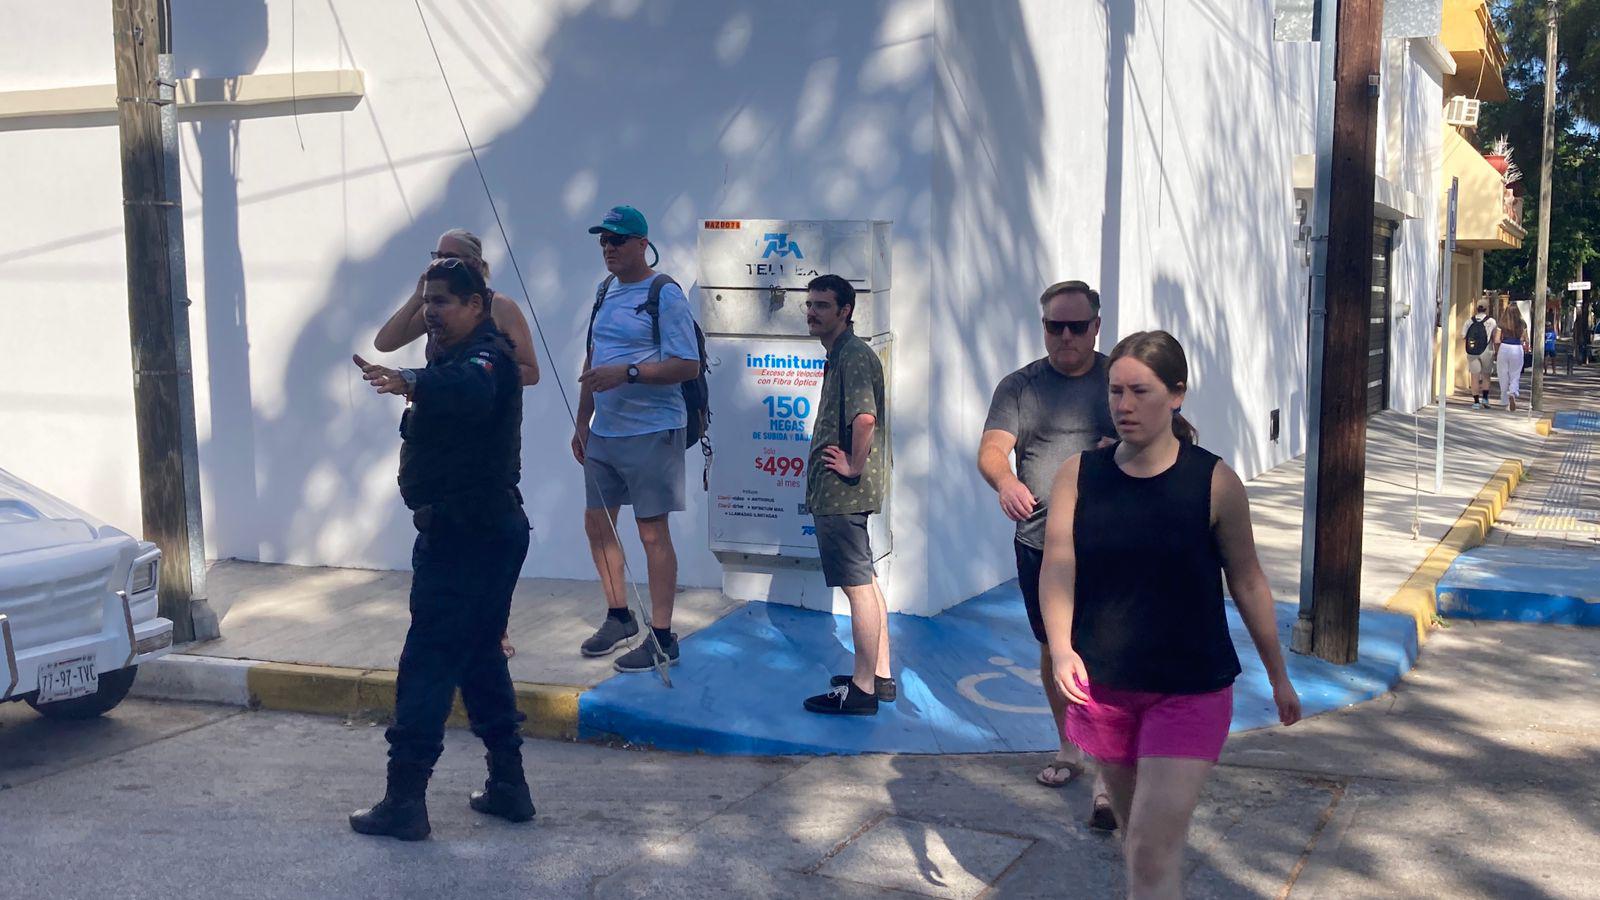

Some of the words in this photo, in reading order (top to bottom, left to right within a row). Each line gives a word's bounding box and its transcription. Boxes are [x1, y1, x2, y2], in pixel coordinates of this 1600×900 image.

[761, 369, 785, 377] Exceso
[786, 369, 794, 377] de
[772, 377, 792, 386] Fibra
[762, 395, 810, 419] 150
[770, 419, 805, 432] MEGAS
[752, 431, 762, 440] DE
[763, 431, 788, 441] SUBIDA
[776, 478, 784, 487] al
[784, 479, 801, 487] mes
